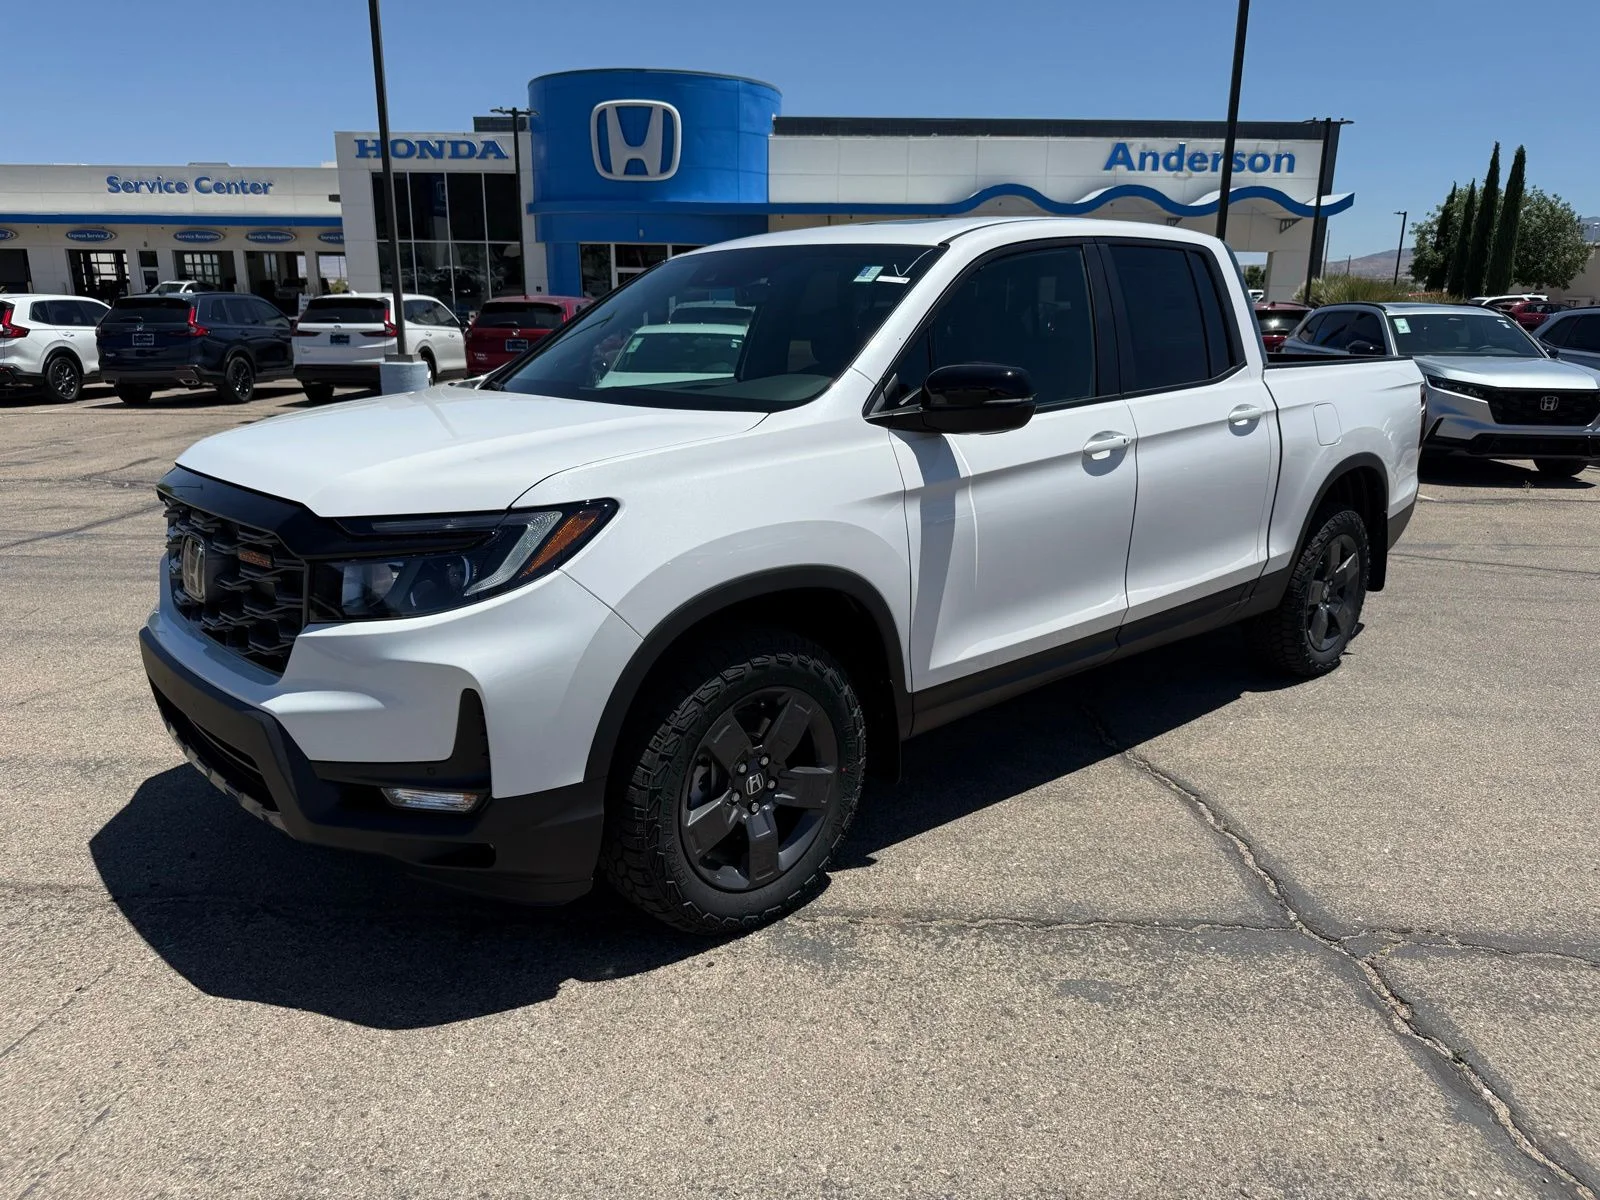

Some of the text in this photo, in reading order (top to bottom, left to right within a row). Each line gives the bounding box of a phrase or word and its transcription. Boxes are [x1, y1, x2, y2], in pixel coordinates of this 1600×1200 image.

[353, 138, 509, 160] HONDA
[1103, 141, 1296, 174] Anderson
[106, 175, 273, 195] Service Center
